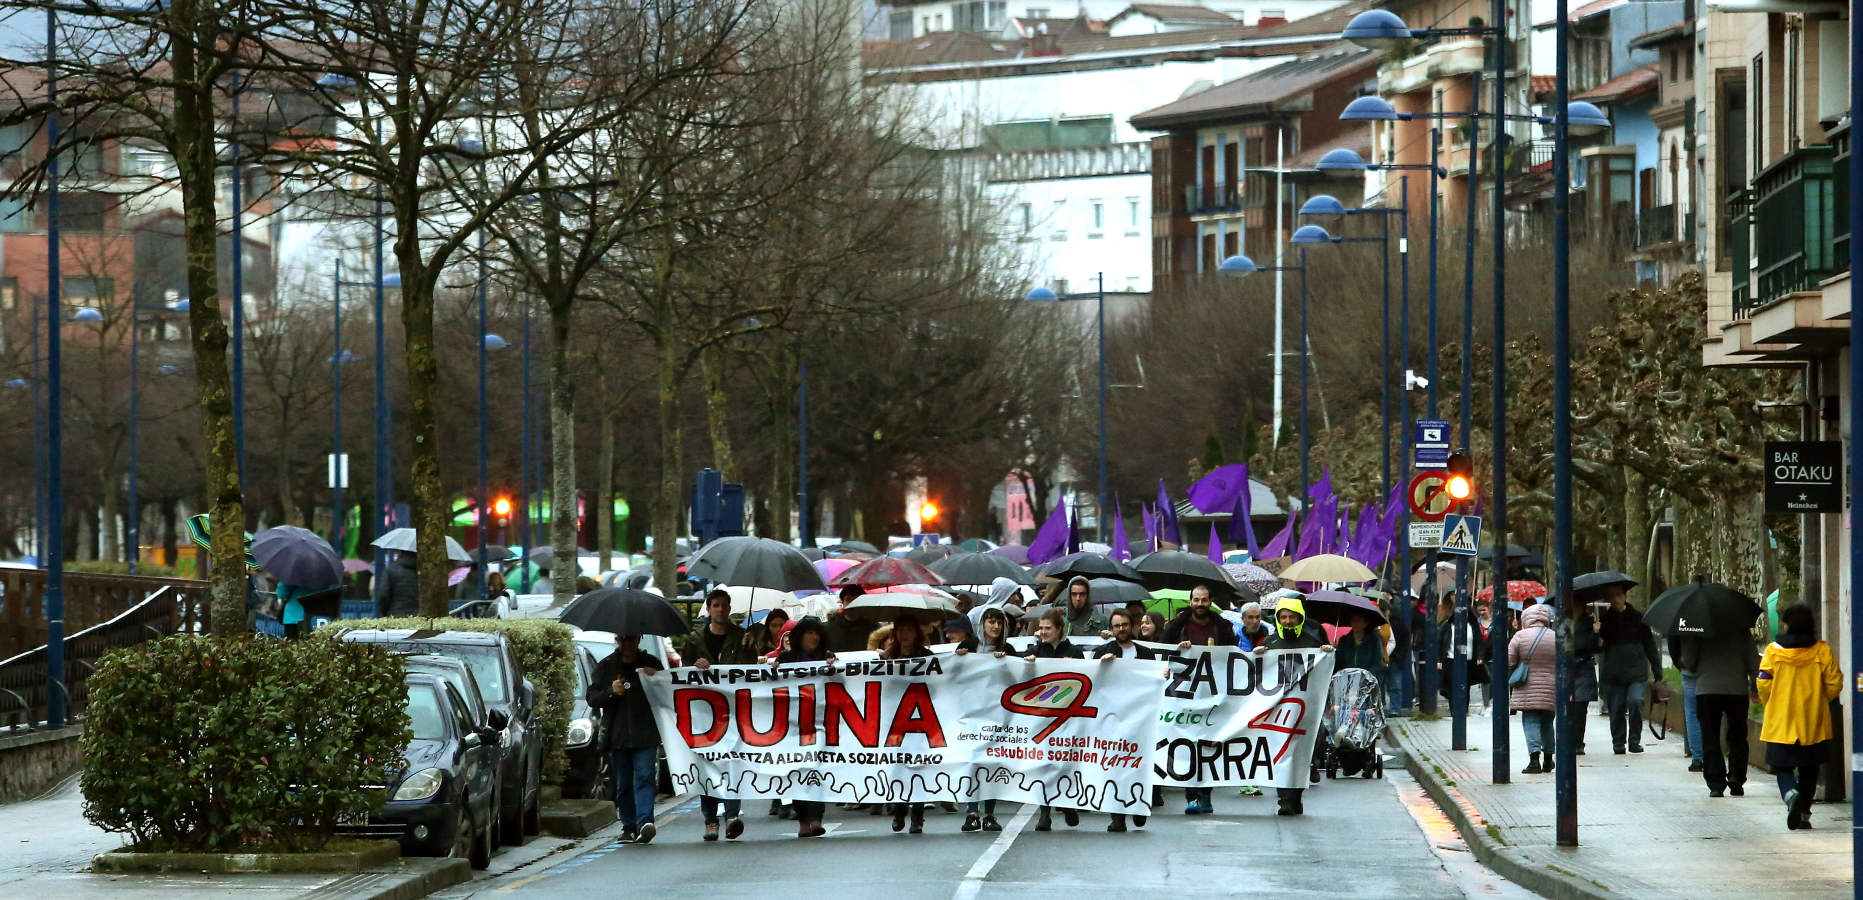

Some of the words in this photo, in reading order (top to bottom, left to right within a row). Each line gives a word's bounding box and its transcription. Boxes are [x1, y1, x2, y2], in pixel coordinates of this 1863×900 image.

[1774, 452, 1799, 463] BAR
[1774, 466, 1833, 480] OTAKU
[673, 681, 948, 749] DUINA
[1159, 704, 1220, 727] ocial
[1004, 725, 1014, 733] de
[1016, 725, 1029, 734] los
[957, 732, 994, 741] derechos
[994, 735, 1028, 744] sociales
[1048, 735, 1091, 748] euskal
[1093, 737, 1139, 753] herriko
[776, 750, 846, 765] ALDAKETA
[848, 752, 943, 766] SOZIALERAKO
[986, 746, 1044, 760] eskubide
[1047, 749, 1098, 763] sozialen
[1100, 750, 1143, 771] karta
